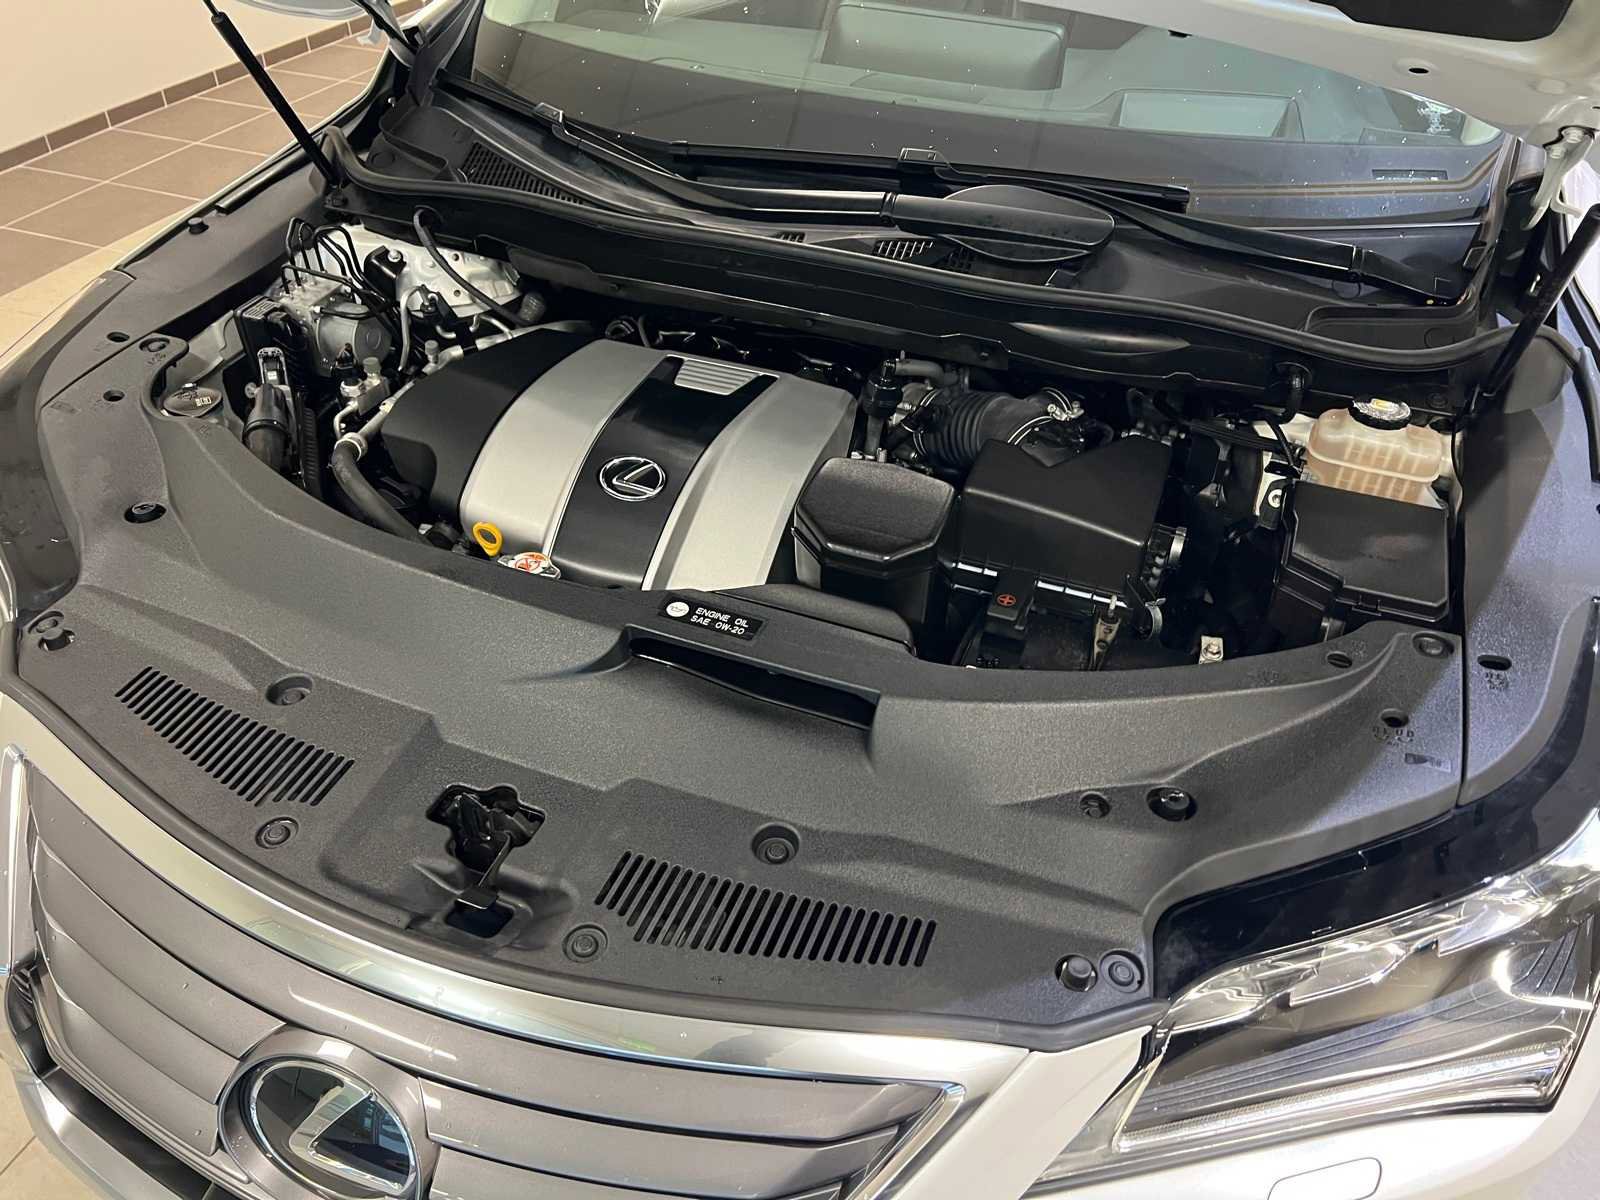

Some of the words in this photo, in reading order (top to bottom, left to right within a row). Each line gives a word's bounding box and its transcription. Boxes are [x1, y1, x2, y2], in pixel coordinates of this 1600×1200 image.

[690, 614, 711, 626] SAE
[715, 621, 745, 635] 0W-20
[695, 607, 731, 623] ENGINE
[734, 618, 749, 628] OIL
